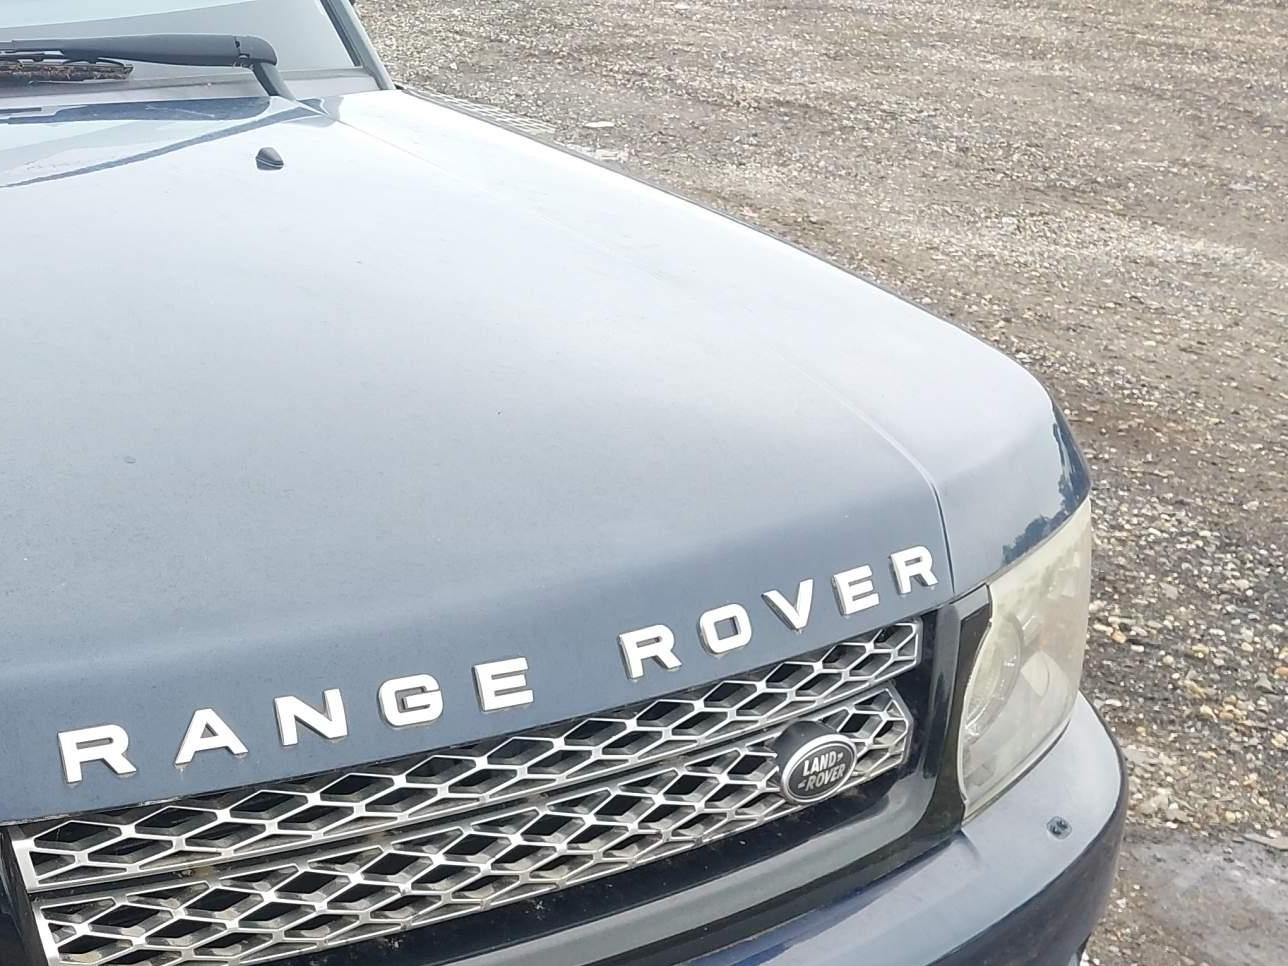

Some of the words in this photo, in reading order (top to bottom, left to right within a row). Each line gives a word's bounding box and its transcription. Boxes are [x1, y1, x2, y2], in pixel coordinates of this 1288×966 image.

[59, 657, 535, 783] RANGE
[619, 545, 939, 679] ROVER
[804, 752, 837, 776] LAND
[805, 763, 846, 791] ROVER
